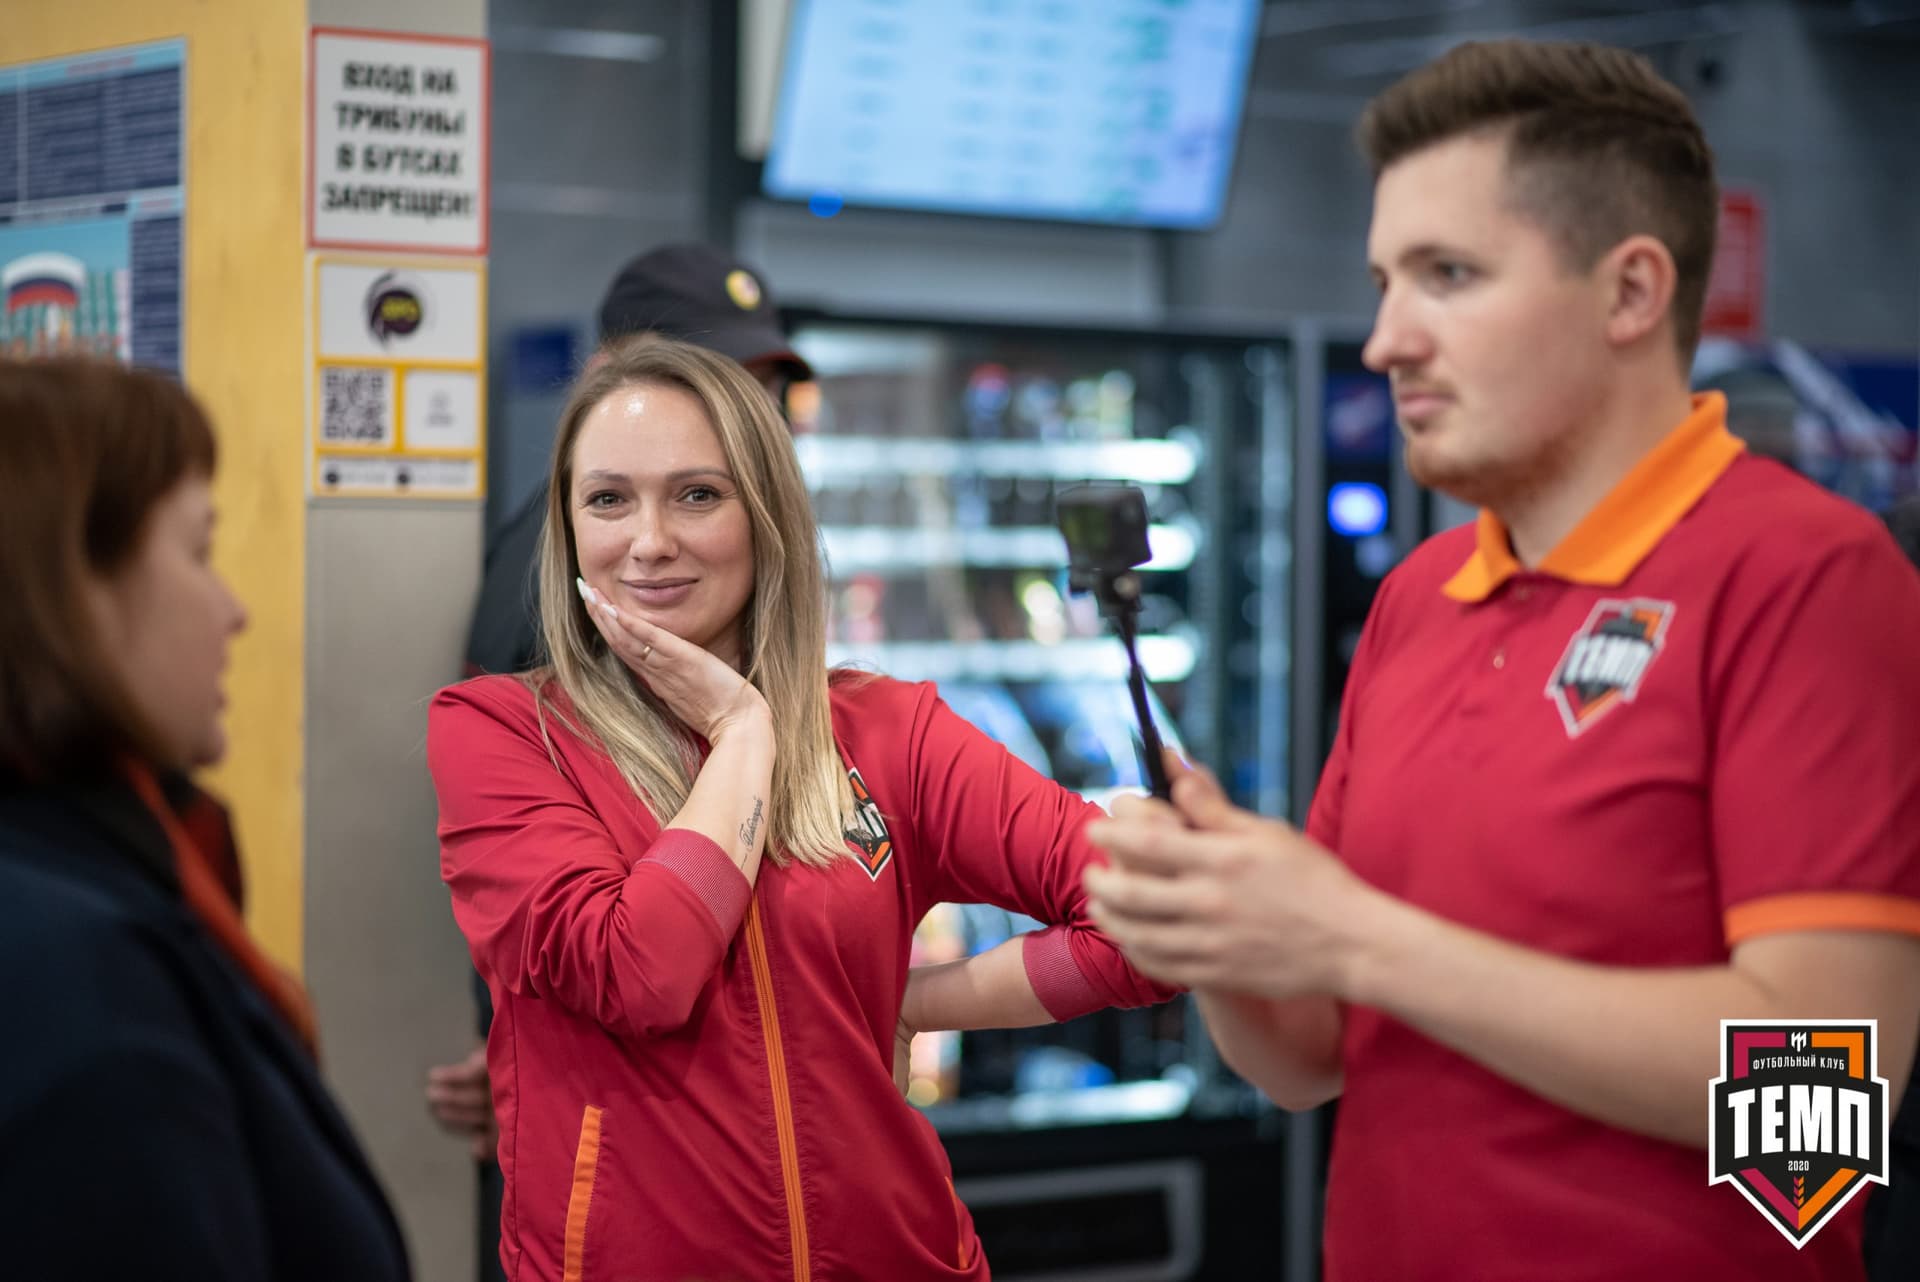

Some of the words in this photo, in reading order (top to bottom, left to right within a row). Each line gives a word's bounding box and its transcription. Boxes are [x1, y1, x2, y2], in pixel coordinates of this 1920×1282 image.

[342, 61, 415, 96] ВХОД
[422, 68, 457, 95] НА
[335, 101, 465, 135] ТРИБУНЫ
[336, 143, 355, 172] В
[362, 144, 460, 176] БУТСАХ
